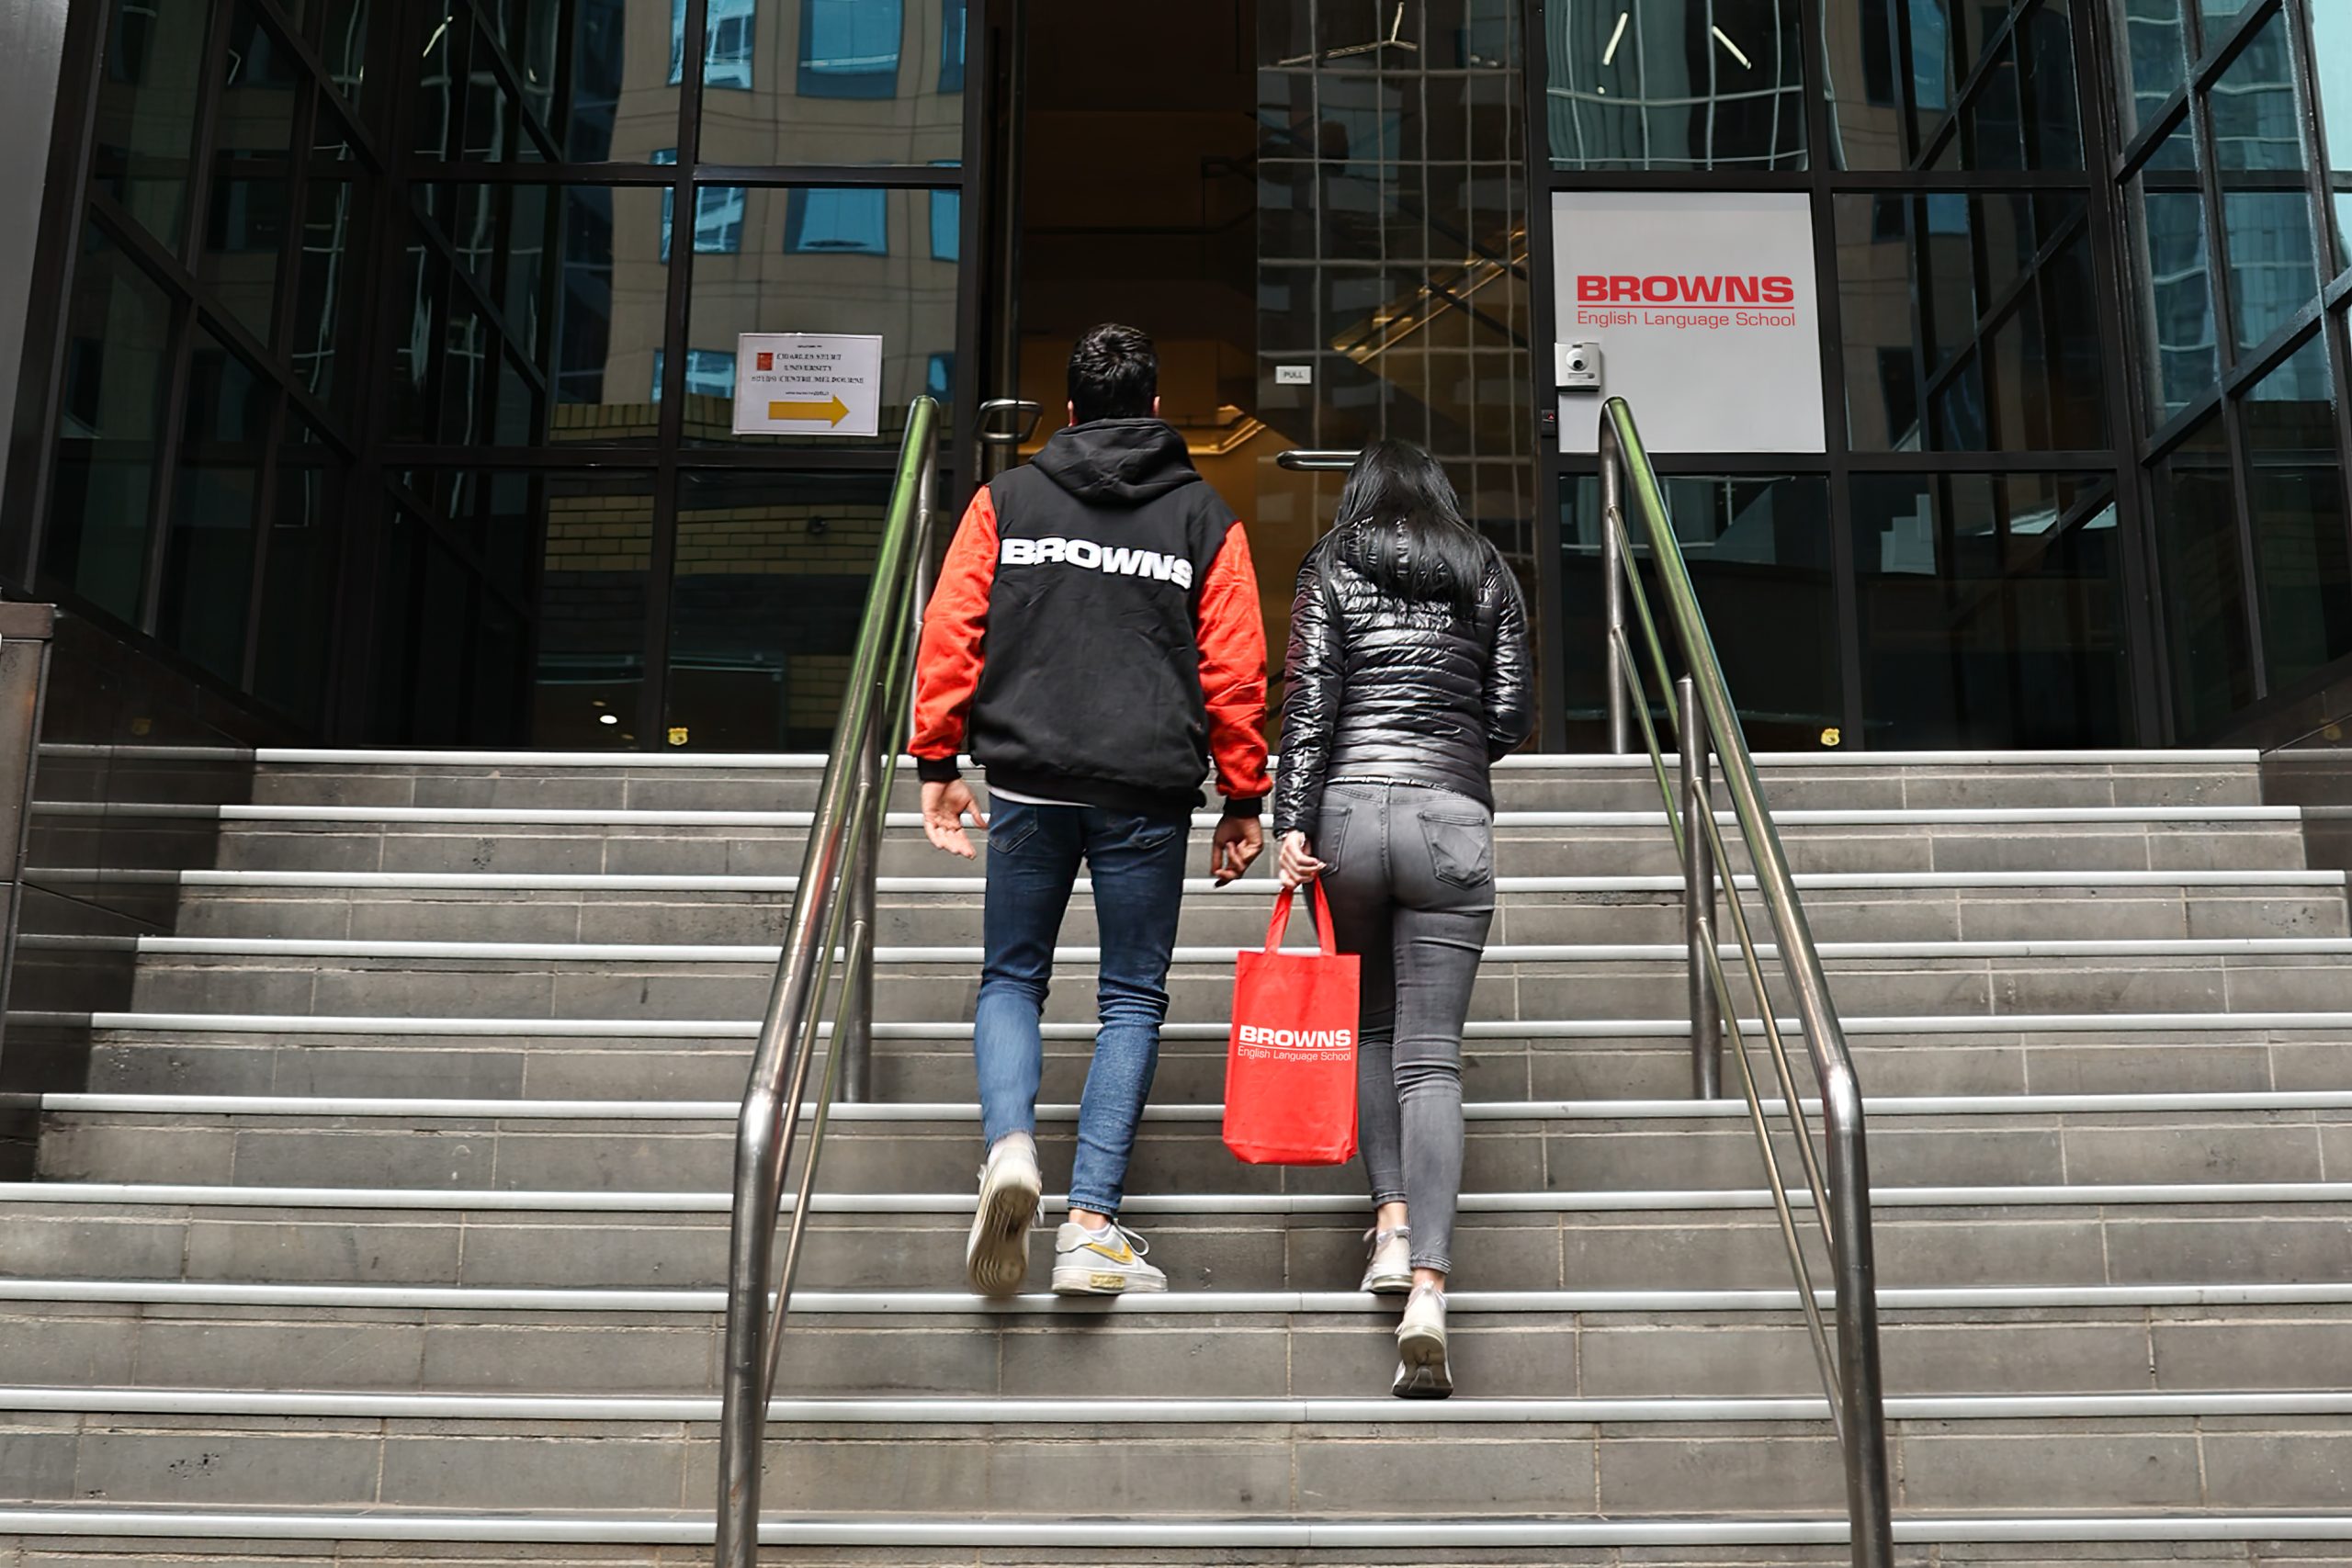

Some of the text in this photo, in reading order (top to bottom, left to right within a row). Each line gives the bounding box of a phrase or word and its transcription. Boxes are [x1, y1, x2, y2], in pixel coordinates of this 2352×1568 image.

[1577, 275, 1795, 303] BROWNS
[1577, 310, 1796, 330] English Language School
[776, 353, 814, 361] CHARLES
[1001, 537, 1193, 589] BROWNS
[1238, 1024, 1351, 1047] BROWNS
[1238, 1045, 1351, 1062] English Language School
